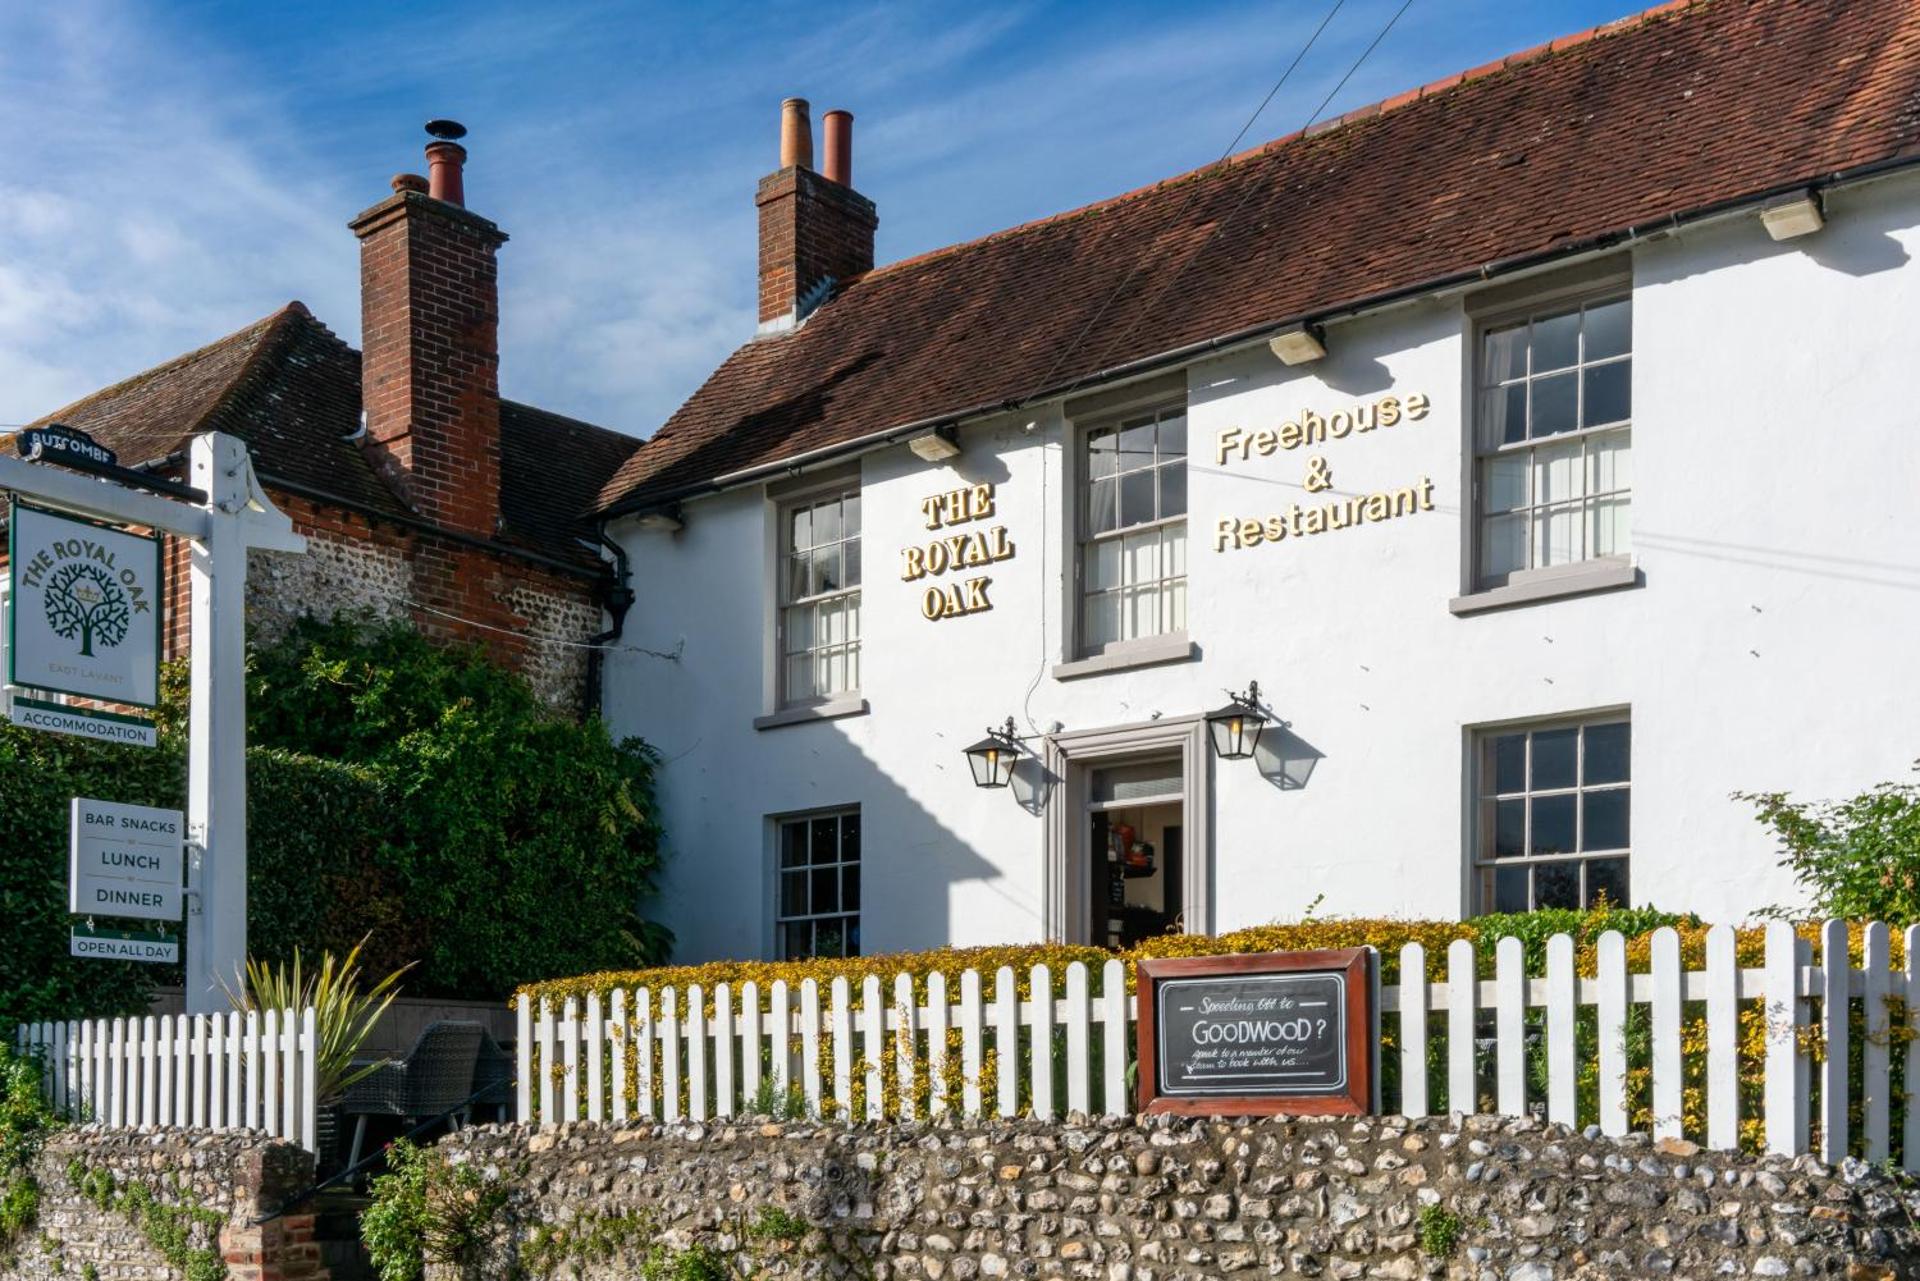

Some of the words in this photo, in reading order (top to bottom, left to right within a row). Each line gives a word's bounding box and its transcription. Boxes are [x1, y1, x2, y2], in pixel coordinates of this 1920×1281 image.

[1215, 391, 1431, 465] Freehouse
[31, 432, 111, 463] BUTCOMBE
[1303, 455, 1334, 493] &
[922, 483, 996, 531] THE
[1212, 474, 1435, 552] Restaurant
[901, 525, 1016, 582] ROYAL
[22, 549, 55, 588] THE
[52, 538, 116, 571] ROYAL
[120, 568, 151, 614] OAK
[922, 576, 993, 622] OAK
[48, 662, 78, 676] EAST
[23, 712, 147, 741] ACCOMMODATION
[85, 813, 115, 827] BAR
[121, 817, 177, 834] SNACKS
[101, 851, 161, 871] LUNCH
[96, 889, 164, 908] DINNER
[77, 941, 116, 955] OPEN
[118, 944, 143, 957] ALL
[145, 946, 172, 959] DAY
[1198, 996, 1254, 1015] Speeding
